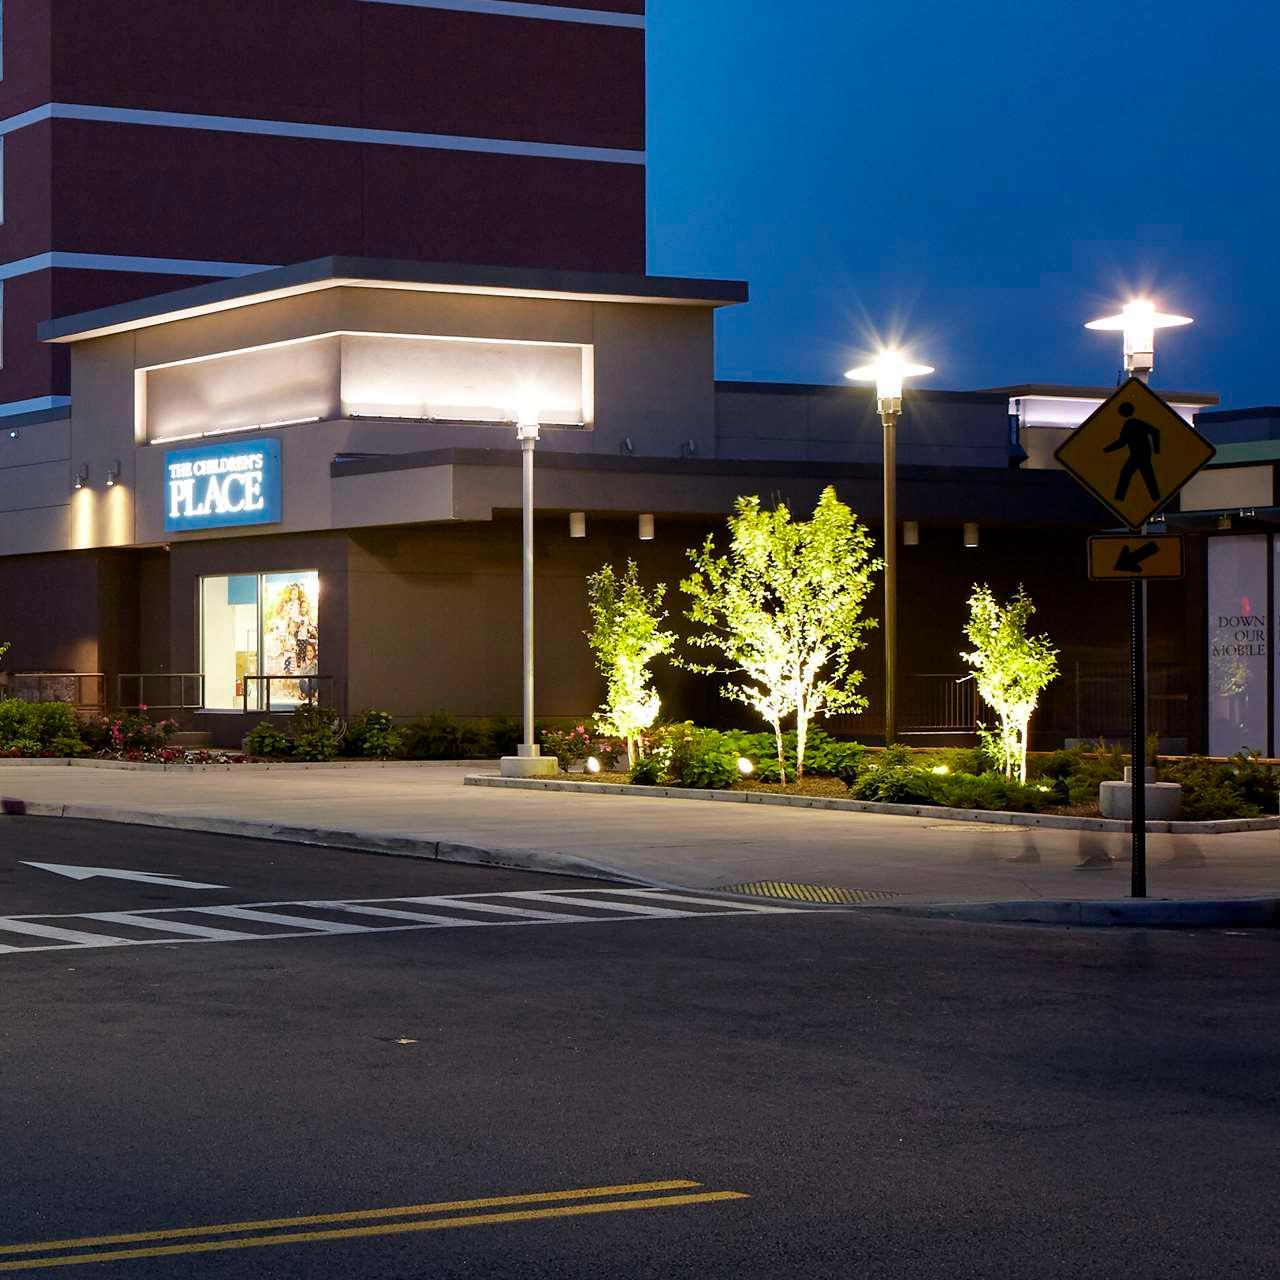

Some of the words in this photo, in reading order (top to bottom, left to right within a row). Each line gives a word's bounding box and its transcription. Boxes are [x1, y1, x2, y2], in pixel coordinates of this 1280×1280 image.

[168, 463, 193, 479] THE
[169, 471, 265, 518] PLACE
[1234, 630, 1265, 641] OUR
[1212, 643, 1265, 657] MOBILE
